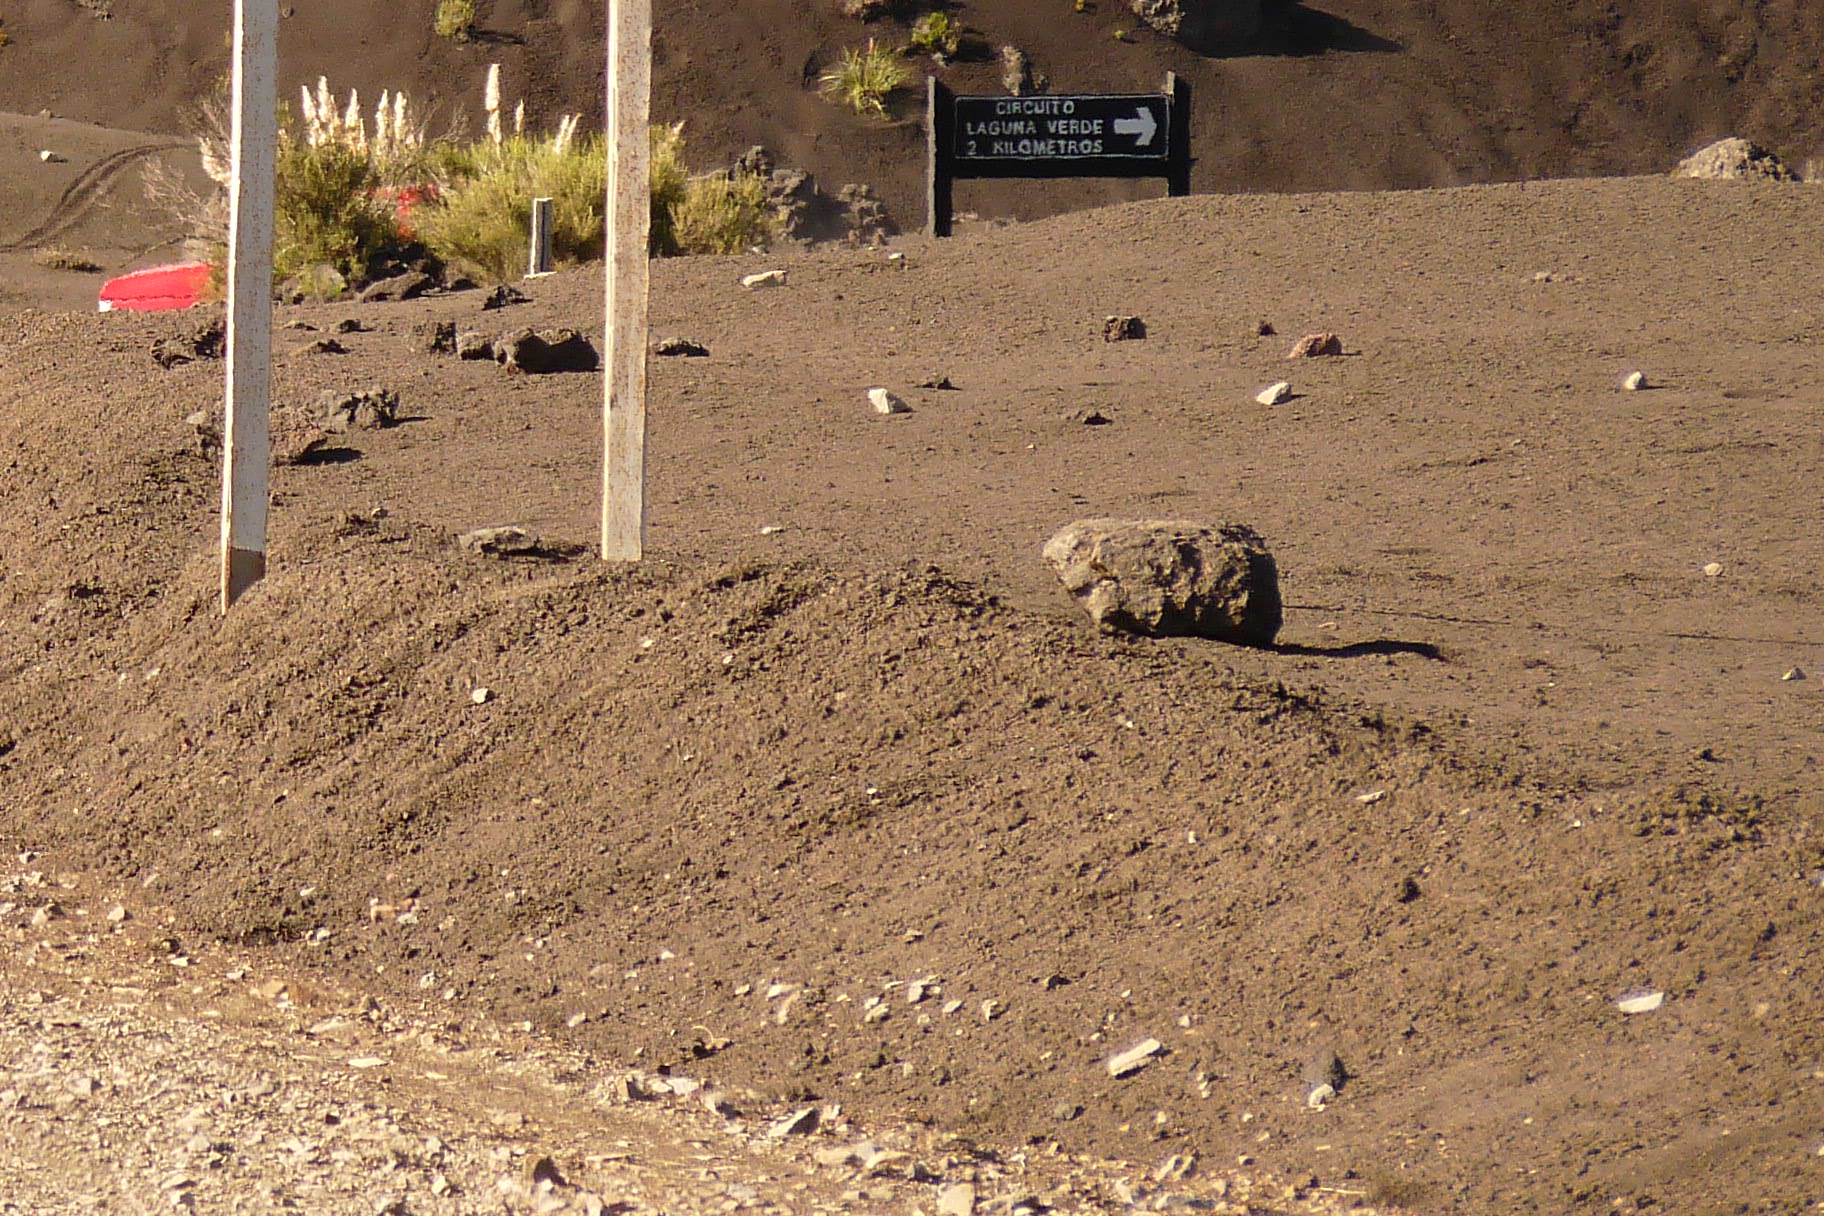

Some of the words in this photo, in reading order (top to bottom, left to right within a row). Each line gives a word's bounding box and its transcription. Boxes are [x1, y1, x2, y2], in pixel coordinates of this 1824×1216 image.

[996, 100, 1075, 115] CIRCUITO
[966, 121, 1037, 135] LAGUNA
[1047, 120, 1103, 135] VERDE
[967, 141, 977, 155] 2
[993, 140, 1103, 155] KILOMETROS
